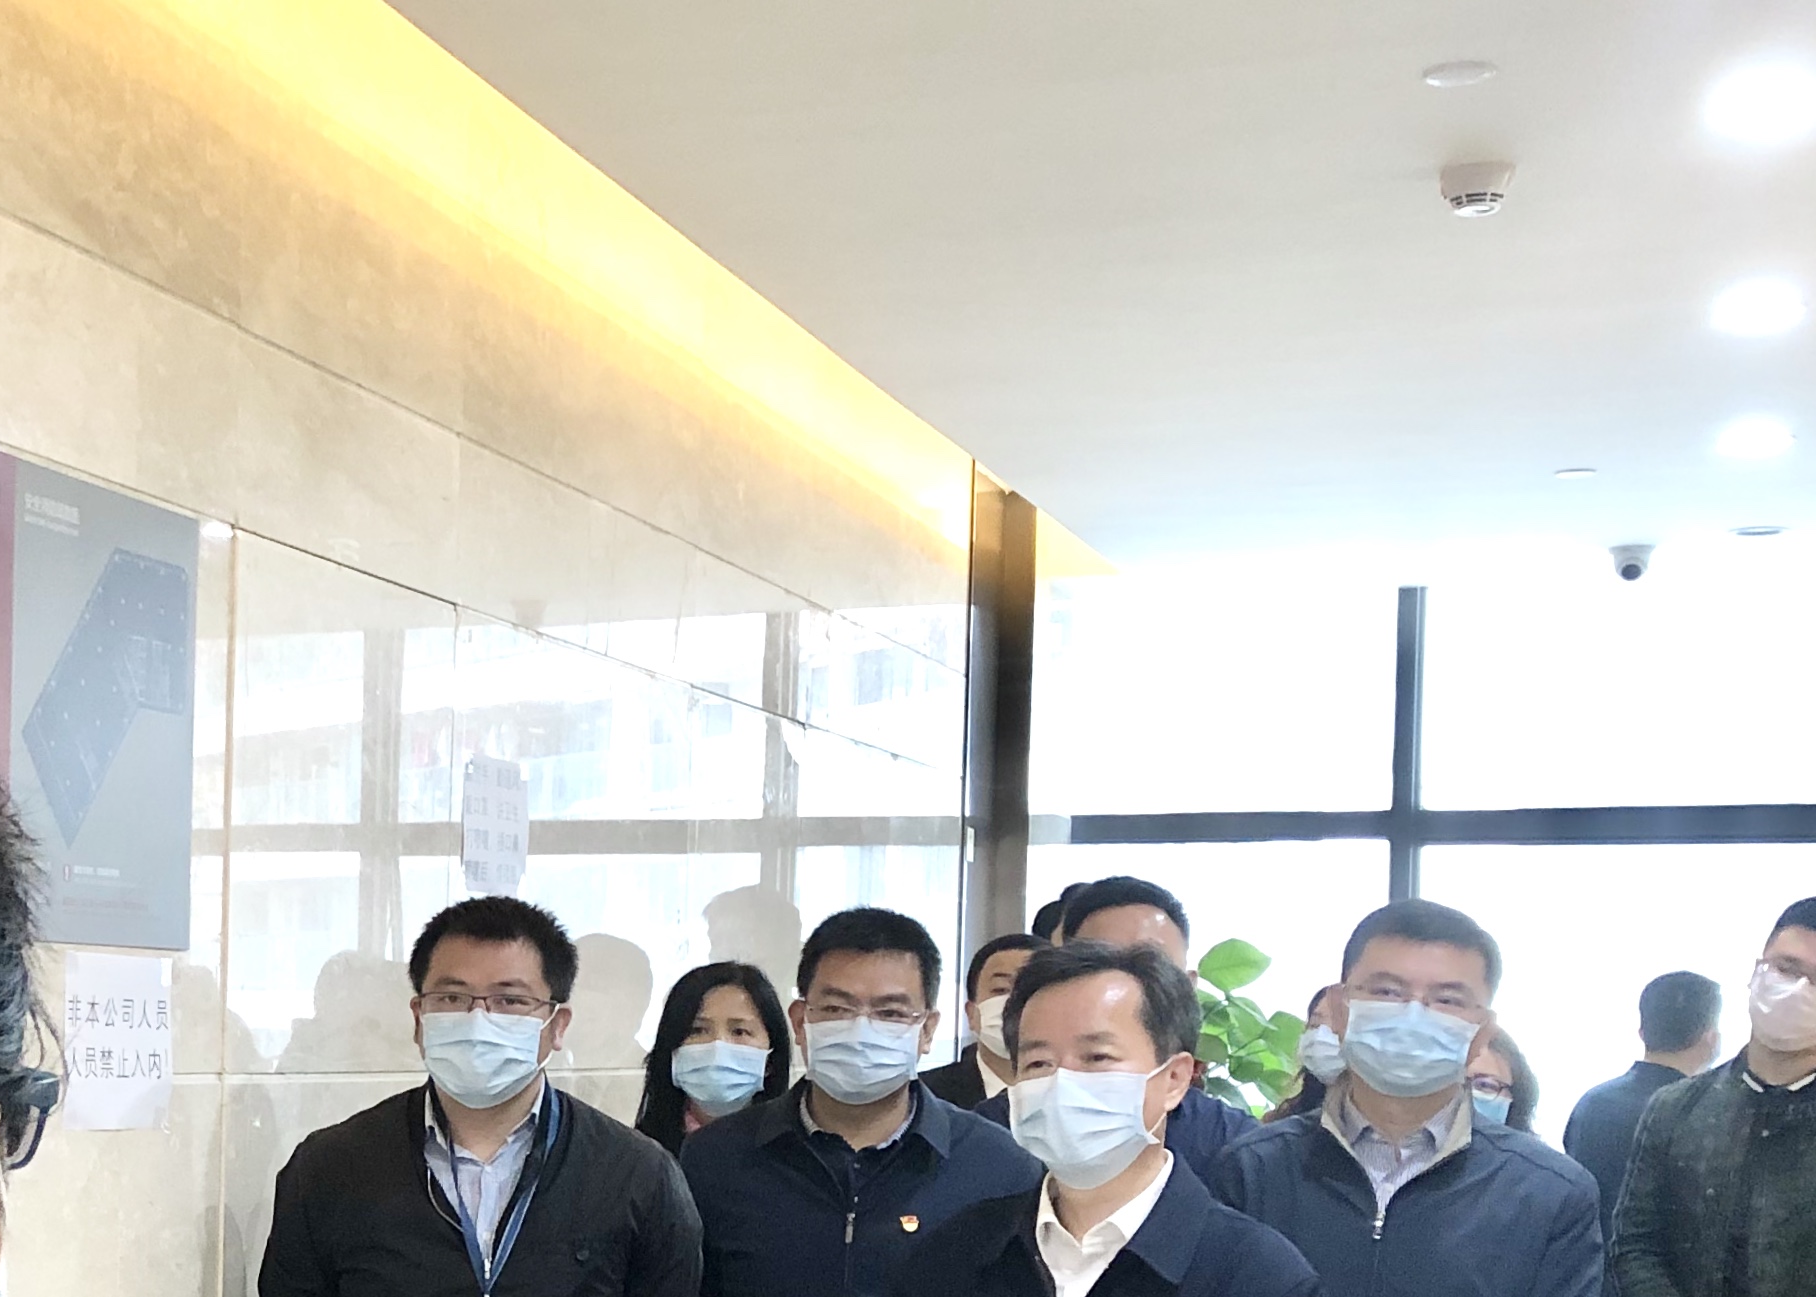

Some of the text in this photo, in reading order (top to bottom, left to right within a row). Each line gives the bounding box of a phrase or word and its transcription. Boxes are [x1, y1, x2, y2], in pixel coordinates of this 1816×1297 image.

[67, 994, 169, 1031] 非本公司人员
